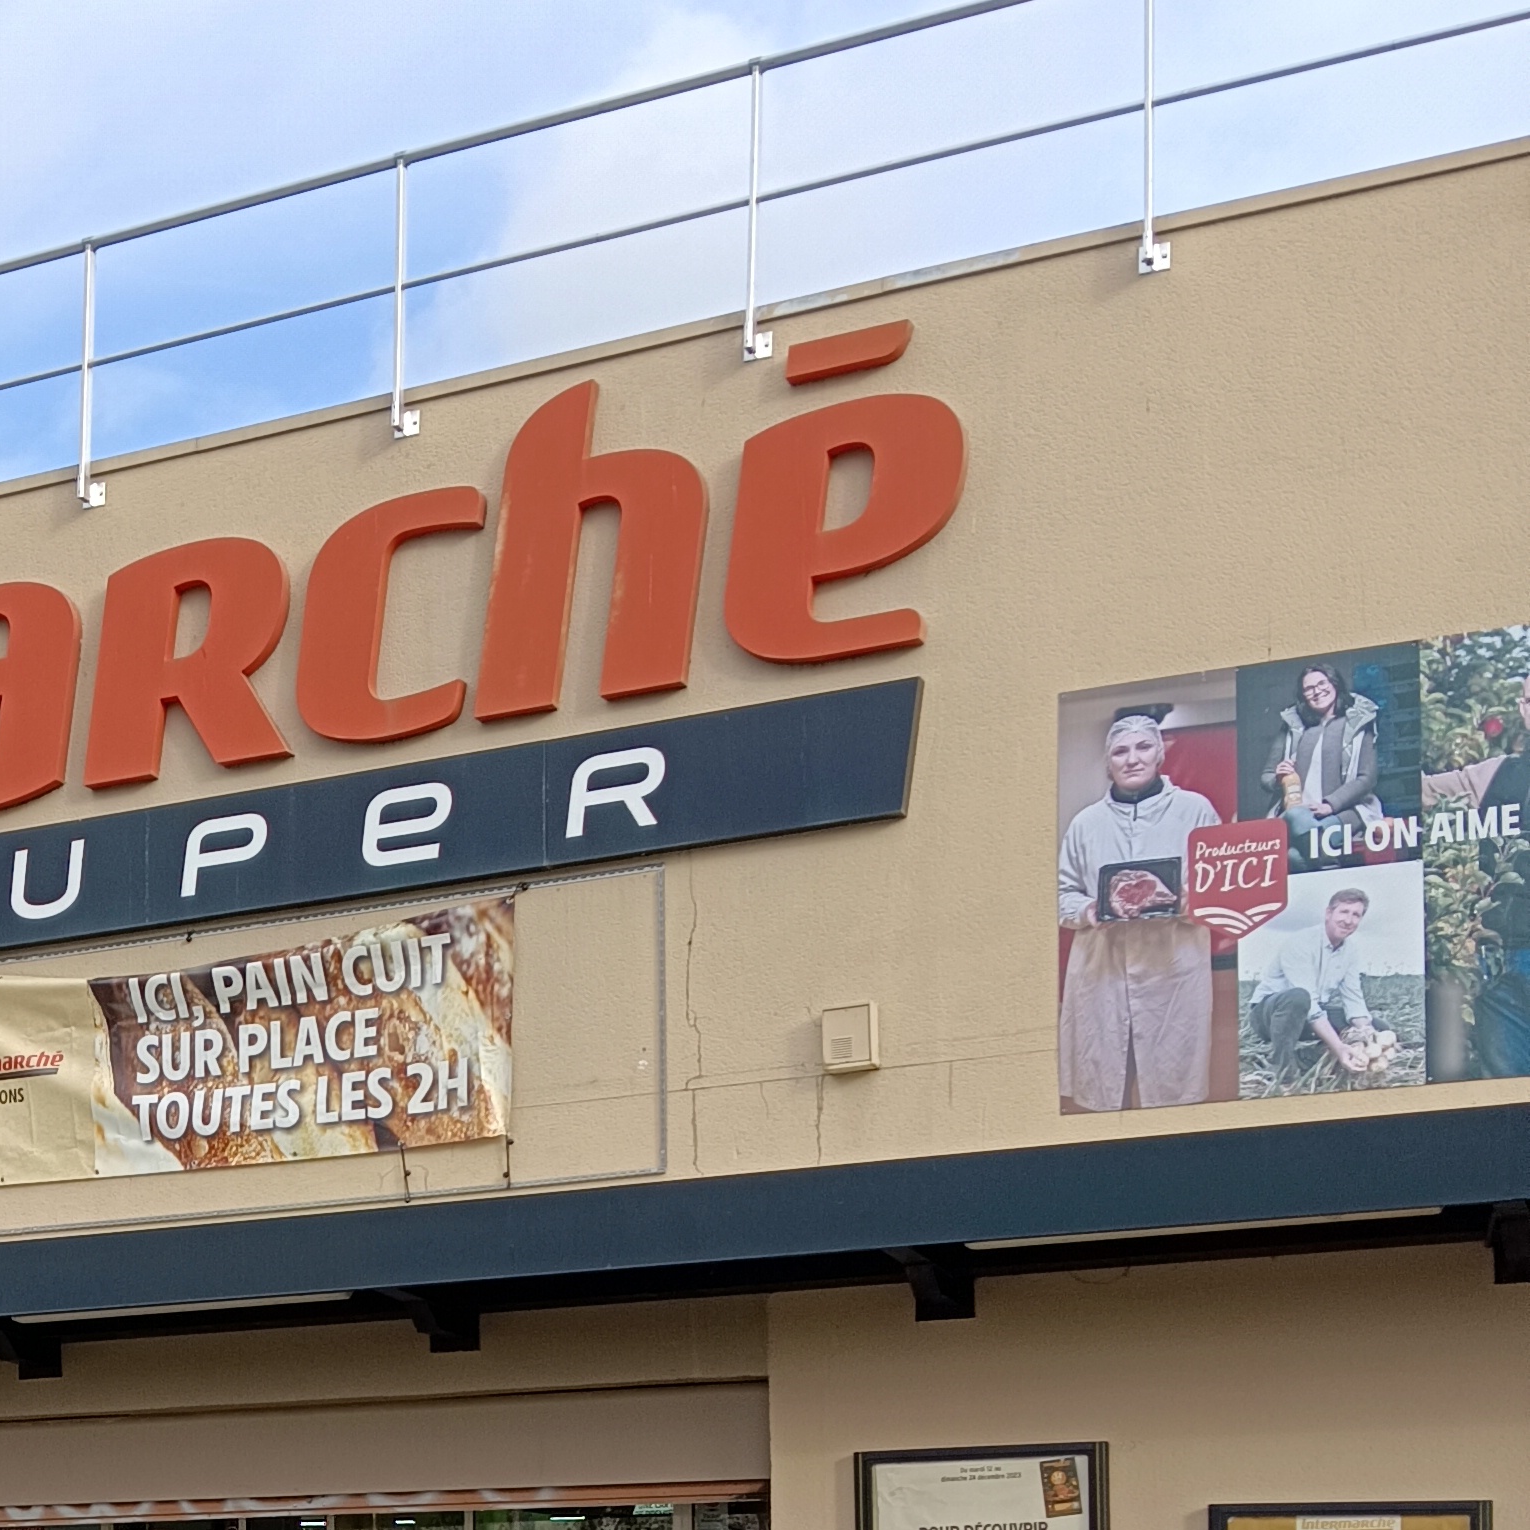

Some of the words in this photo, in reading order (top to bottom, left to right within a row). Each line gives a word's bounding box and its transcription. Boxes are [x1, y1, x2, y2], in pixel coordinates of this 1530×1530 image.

[1194, 836, 1281, 860] Producteurs
[1310, 825, 1353, 859] ICI
[1364, 815, 1419, 852] ON
[1430, 803, 1522, 846] AIME
[1194, 854, 1278, 894] D'ICI
[128, 973, 205, 1028] ICI,
[211, 950, 327, 1016] PAIN
[342, 932, 452, 998] CUIT
[135, 1031, 223, 1086] SUR
[238, 1007, 381, 1075] PLACE
[131, 1078, 302, 1144] TOUTES
[316, 1066, 394, 1126] LES
[407, 1057, 470, 1117] 2H
